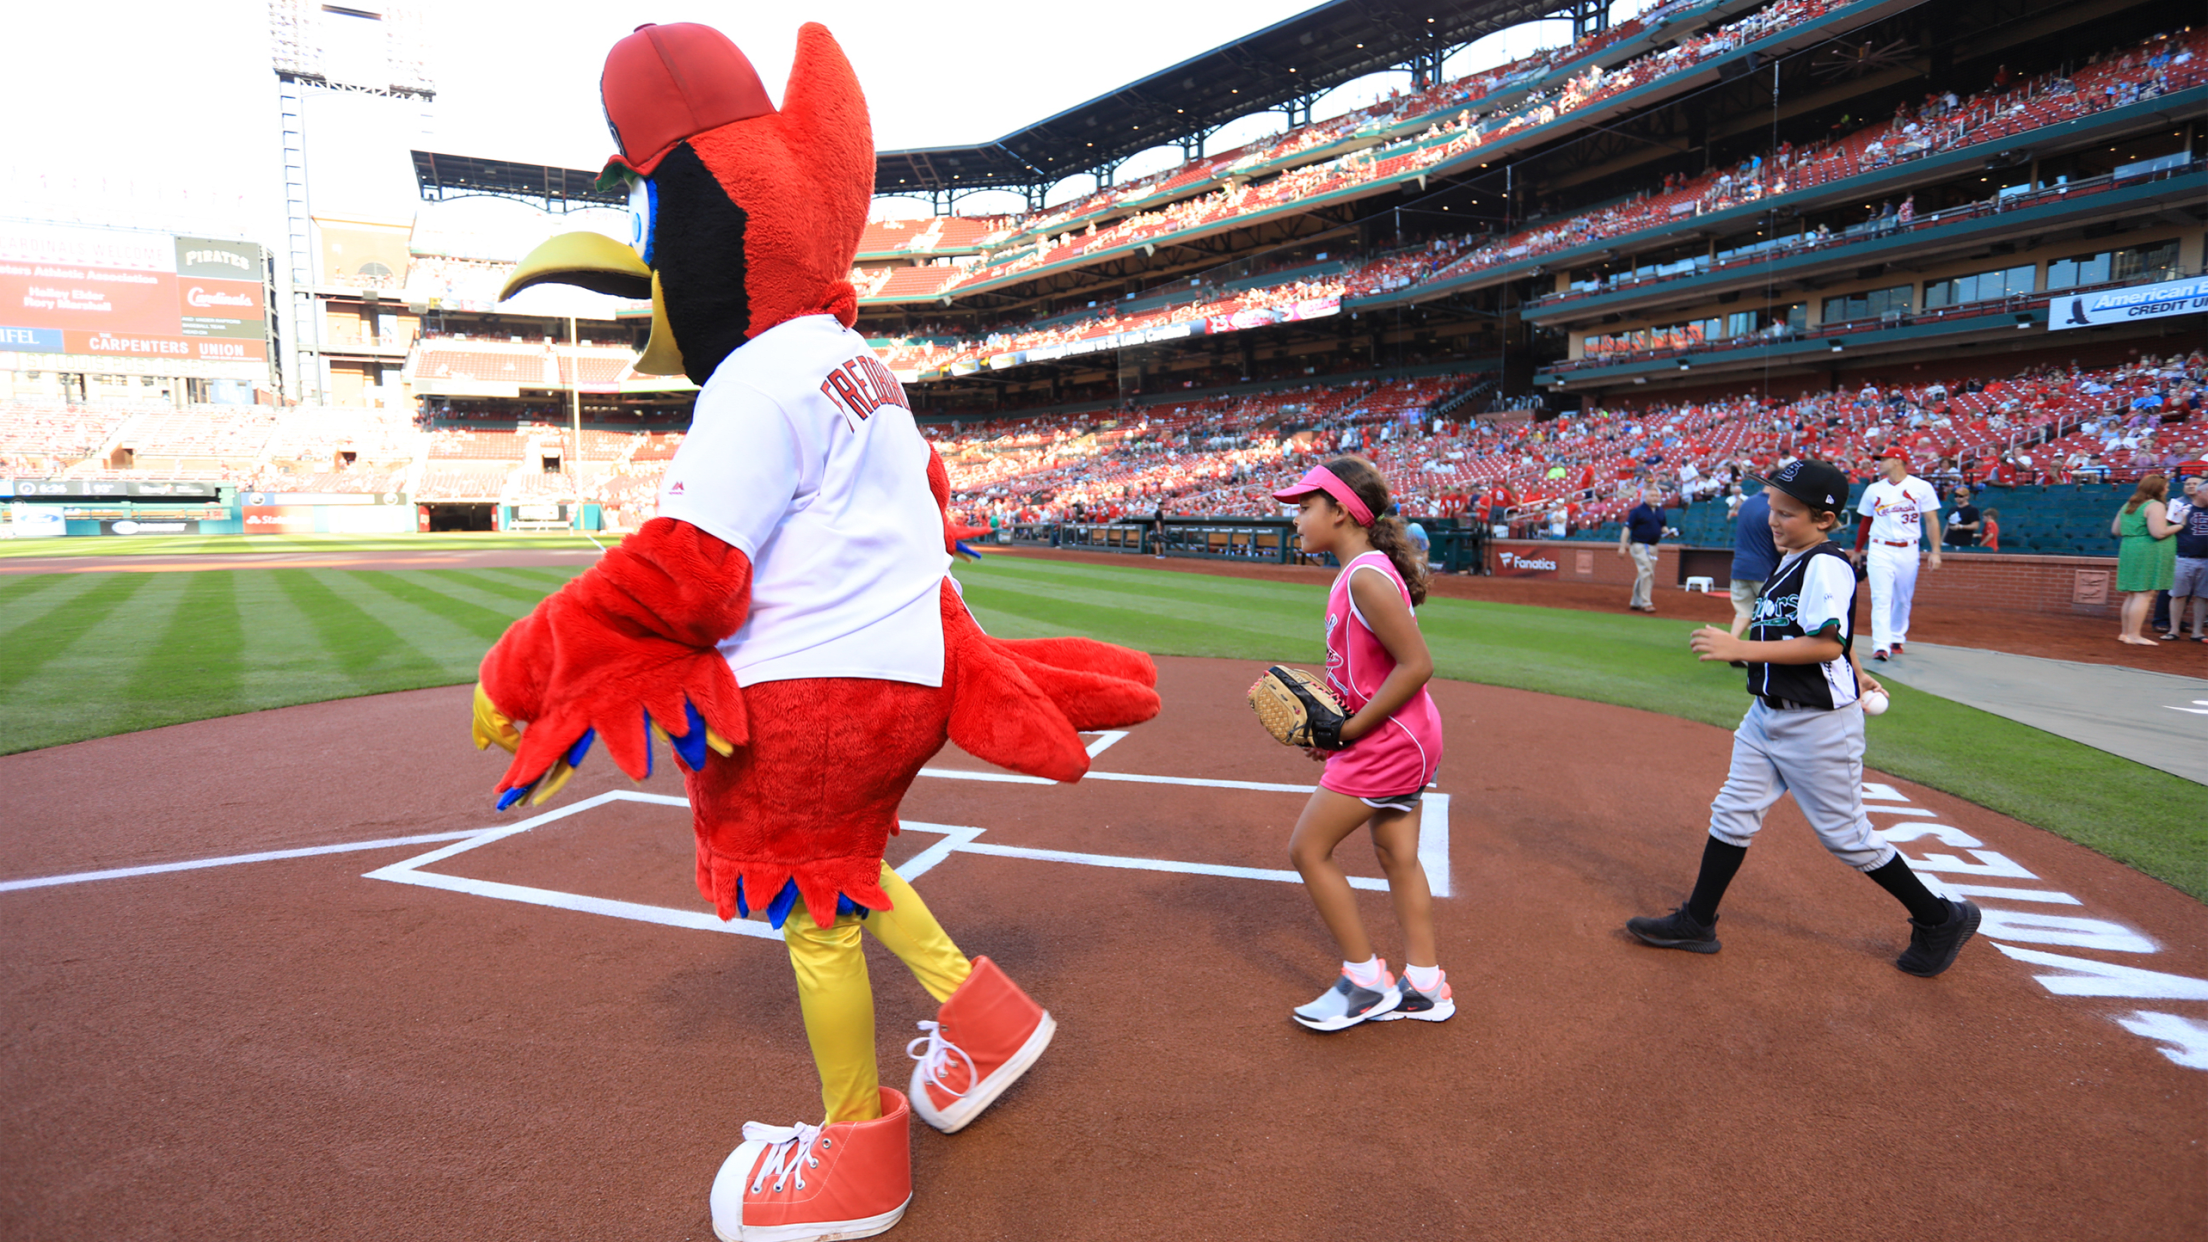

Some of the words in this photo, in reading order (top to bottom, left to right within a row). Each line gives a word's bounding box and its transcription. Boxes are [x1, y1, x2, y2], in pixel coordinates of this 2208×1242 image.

[92, 244, 163, 262] WELCOME
[185, 249, 250, 271] PIRATES
[86, 270, 158, 284] Association
[187, 286, 253, 308] Cardinals
[2093, 284, 2195, 309] American
[2127, 299, 2189, 317] CREDIT
[89, 336, 190, 355] CARPENTERS
[198, 342, 245, 357] UNION
[1900, 512, 1919, 525] 32
[1513, 555, 1557, 571] Fanatics
